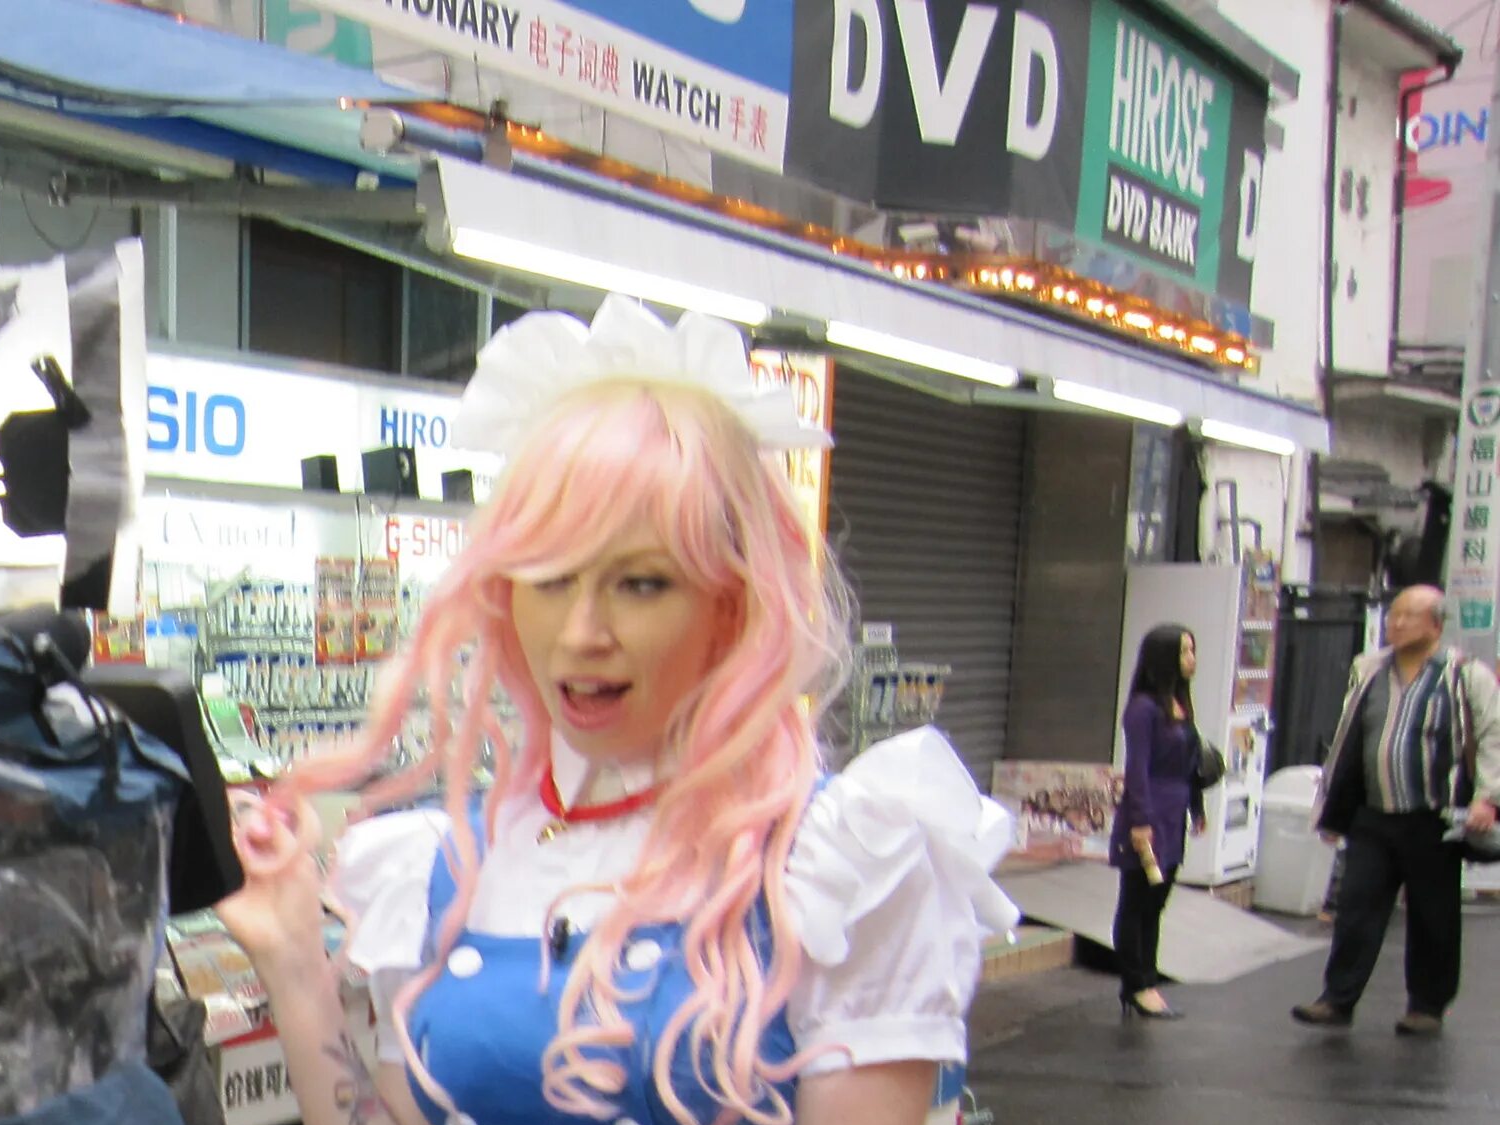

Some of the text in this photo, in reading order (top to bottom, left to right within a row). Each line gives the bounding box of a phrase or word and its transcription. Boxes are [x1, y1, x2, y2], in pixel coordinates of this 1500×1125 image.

[385, 0, 519, 50] ONARY
[633, 60, 720, 130] WATCH
[829, 0, 1058, 161] DVD
[1109, 18, 1214, 198] HIROSE
[1107, 174, 1198, 266] DVD BANK
[146, 386, 246, 457] SIO
[379, 403, 447, 448] HIRO
[386, 515, 470, 559] G-SHO
